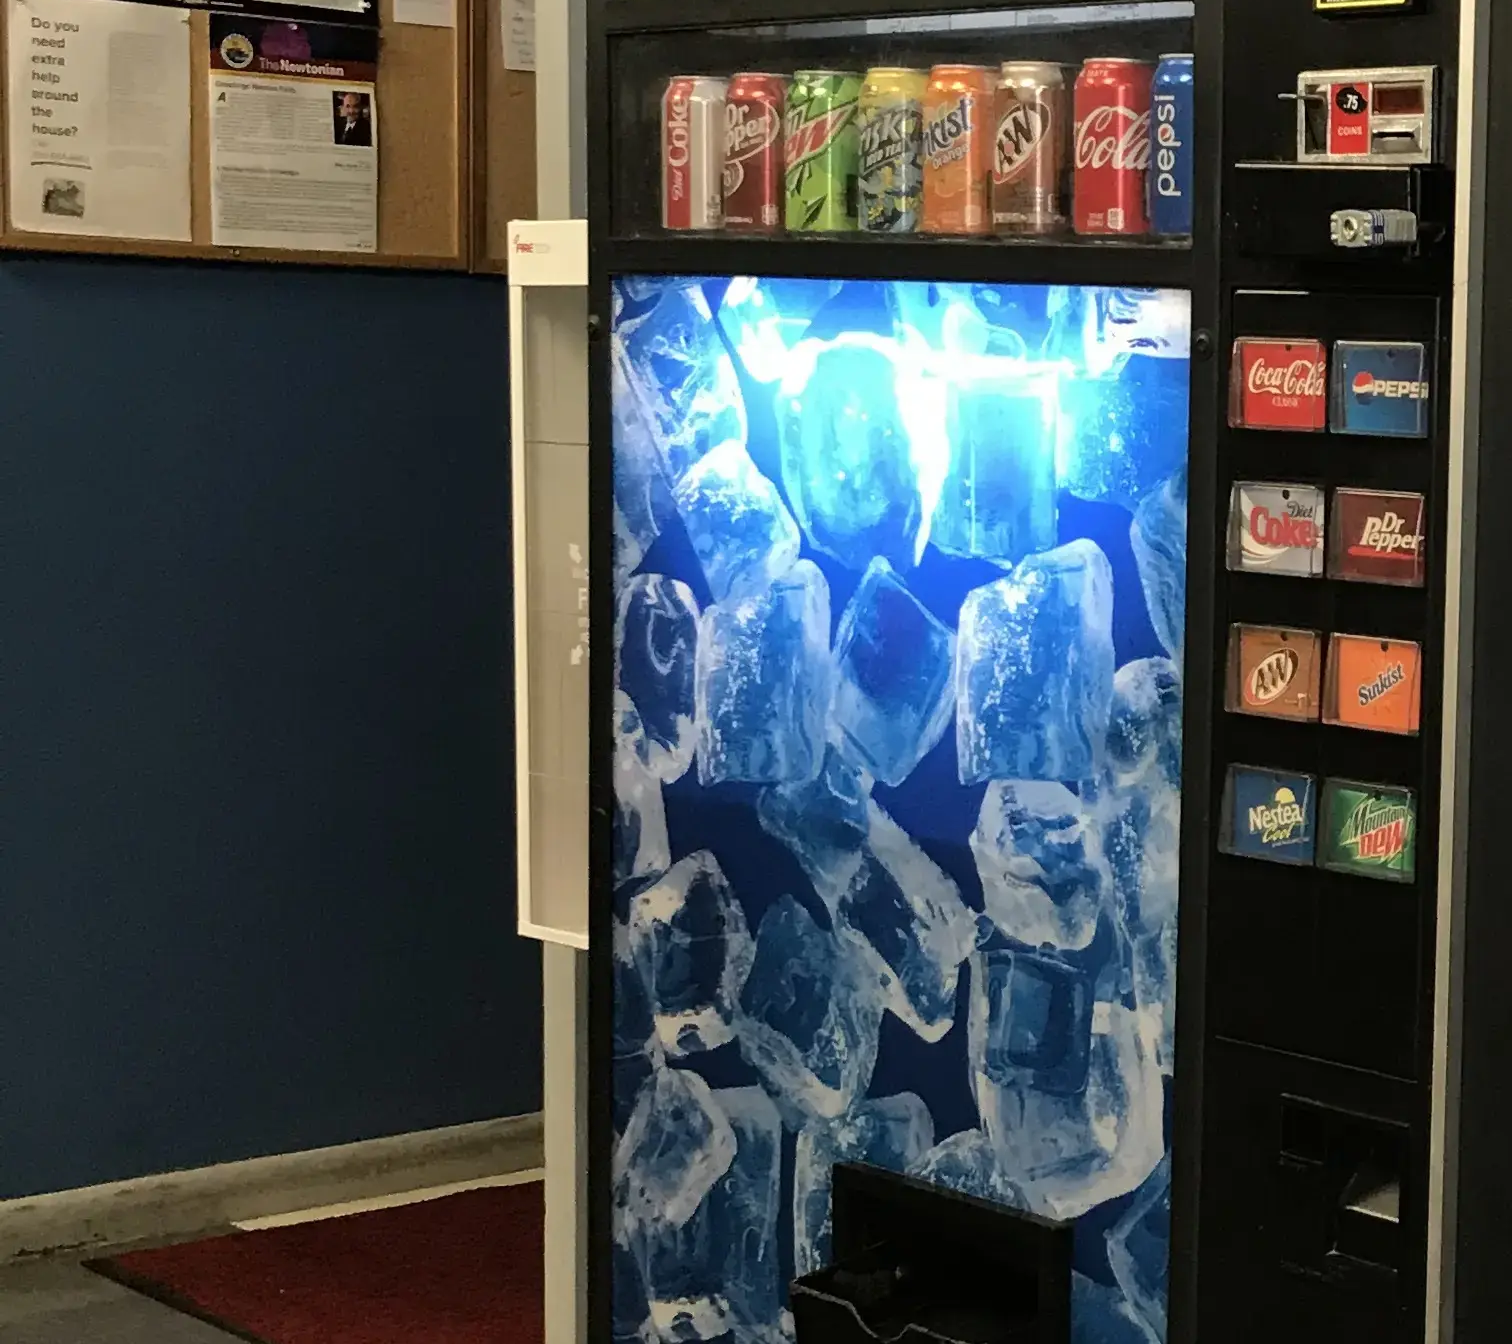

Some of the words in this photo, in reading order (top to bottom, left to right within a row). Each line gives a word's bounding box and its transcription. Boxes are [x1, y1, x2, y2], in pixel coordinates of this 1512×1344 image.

[30, 16, 51, 30] Do
[54, 20, 80, 33] you
[31, 36, 65, 49] need
[31, 54, 65, 67] extra
[280, 58, 344, 77] Newtonian
[31, 69, 60, 85] help
[31, 88, 79, 103] around
[1343, 94, 1359, 110] .75
[31, 106, 53, 118] the
[32, 122, 78, 137] house?
[668, 98, 690, 168] Coke
[1337, 125, 1363, 137] COINS
[1154, 94, 1182, 197] pepsi
[1372, 379, 1429, 399] PEPSI
[1287, 501, 1314, 518] Diet
[1249, 505, 1320, 549] Coke
[1380, 512, 1405, 533] Dr
[1360, 516, 1425, 552] Pepper
[1357, 662, 1405, 706] Sunkist
[1249, 803, 1303, 832] Nestea
[1353, 800, 1410, 836] Mountain
[1262, 823, 1294, 844] Cool
